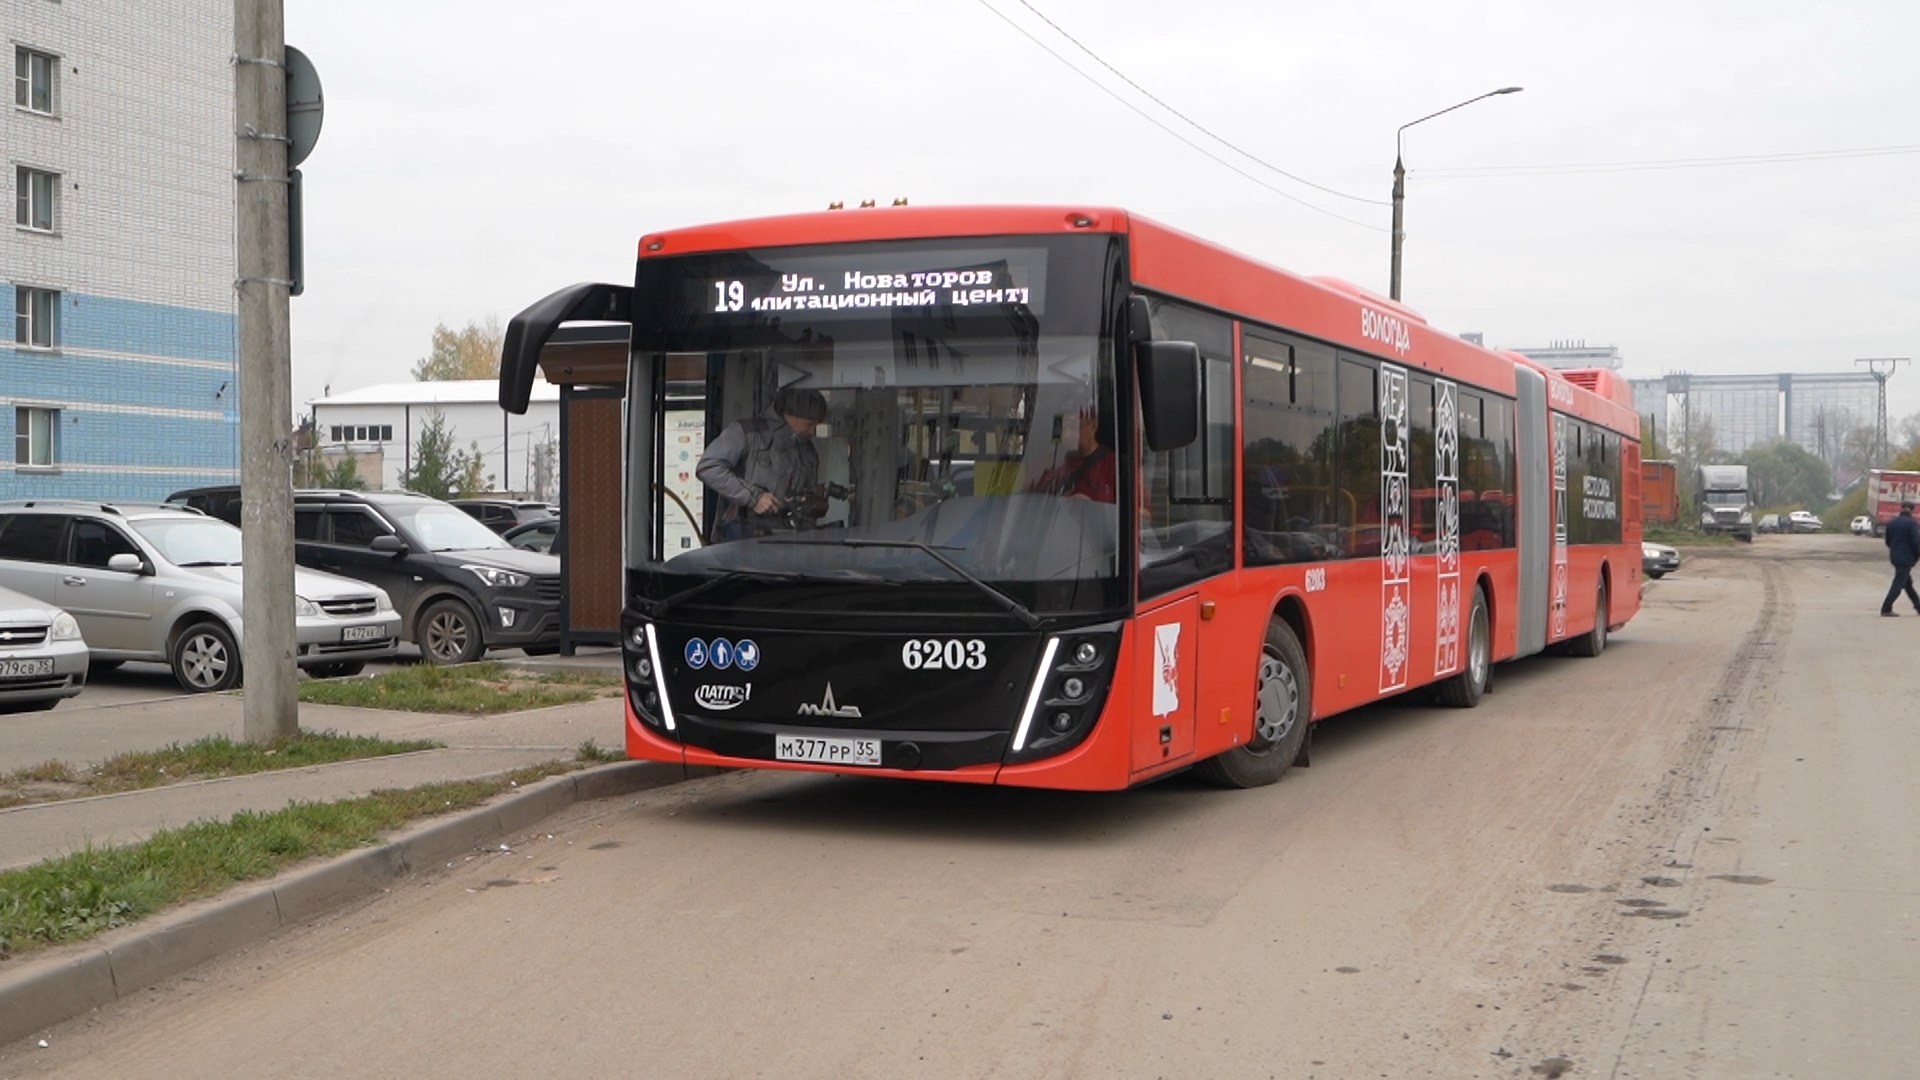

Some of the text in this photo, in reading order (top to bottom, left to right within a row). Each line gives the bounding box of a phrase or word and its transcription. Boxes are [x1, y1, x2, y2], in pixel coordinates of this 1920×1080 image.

[714, 280, 744, 311] 19
[782, 271, 993, 292] Ул. Новаторов
[1361, 307, 1411, 357] ВОЛОГДА
[1305, 567, 1326, 592] 6203
[902, 639, 987, 670] 6203
[856, 740, 874, 756] 35
